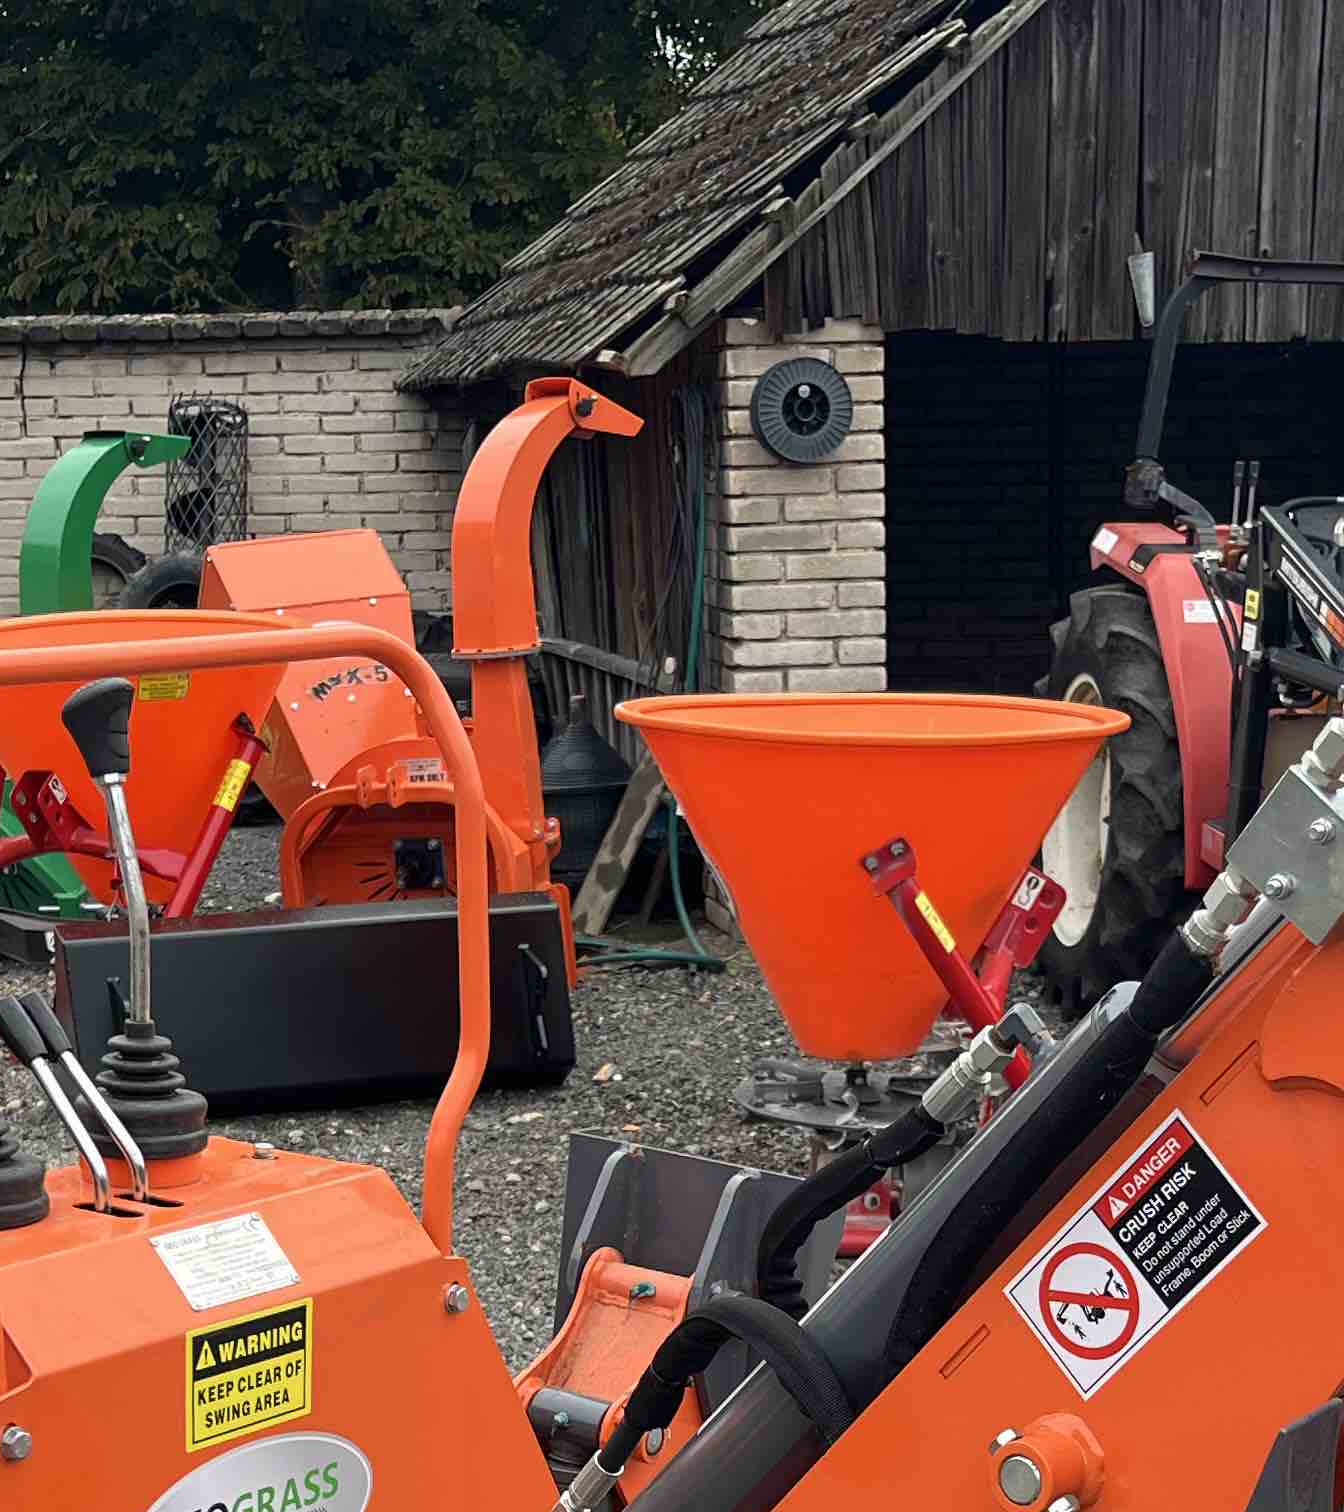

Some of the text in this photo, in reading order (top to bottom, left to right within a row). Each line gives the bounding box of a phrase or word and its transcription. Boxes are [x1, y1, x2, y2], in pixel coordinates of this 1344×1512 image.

[1121, 1136, 1182, 1199] DANGER
[1118, 1161, 1197, 1243] CRUSH RISK
[1132, 1201, 1190, 1260] KEEP CLEAR
[1141, 1193, 1222, 1273] Do not stand under
[1153, 1208, 1229, 1285] unsupported Load
[1190, 1240, 1218, 1269] Boom
[1217, 1229, 1230, 1245] or
[1225, 1209, 1252, 1235] Stick
[218, 1321, 304, 1363] WARNING
[197, 1359, 302, 1407] KEEP CLEAR OF
[205, 1388, 290, 1428] SWING AREA
